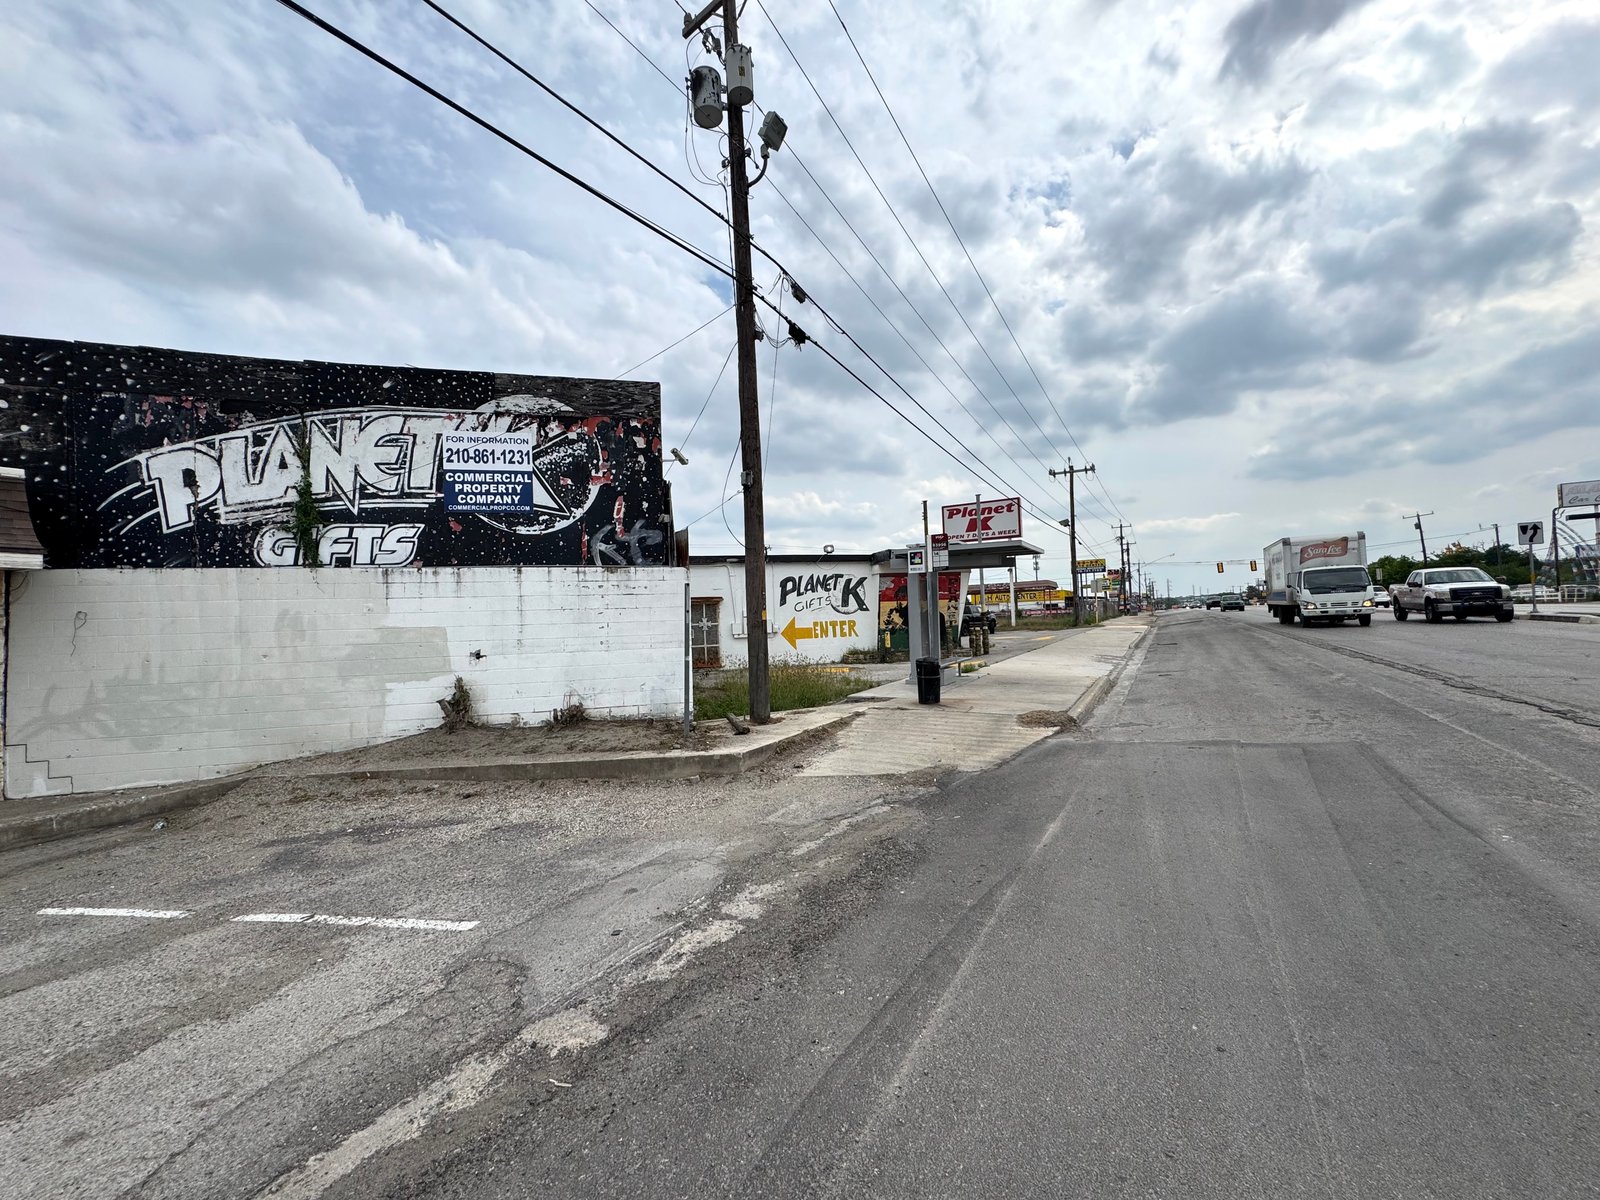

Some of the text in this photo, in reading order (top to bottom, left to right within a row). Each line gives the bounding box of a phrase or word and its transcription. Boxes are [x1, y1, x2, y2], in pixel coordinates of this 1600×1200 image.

[445, 435, 529, 445] FOR INFORMATION
[445, 447, 531, 465] 210-861-1231
[145, 411, 453, 534] PLANET
[445, 472, 532, 483] COMMERCIAL
[454, 483, 523, 493] PROPERTY
[457, 494, 521, 504] COMPANY
[946, 502, 1016, 519] Planet
[965, 515, 995, 533] K
[1304, 545, 1342, 558] Sara Lee
[779, 573, 870, 612] PLANET K
[1016, 592, 1037, 600] ENTER
[793, 595, 832, 612] GIFTS
[812, 619, 859, 638] ENTER
